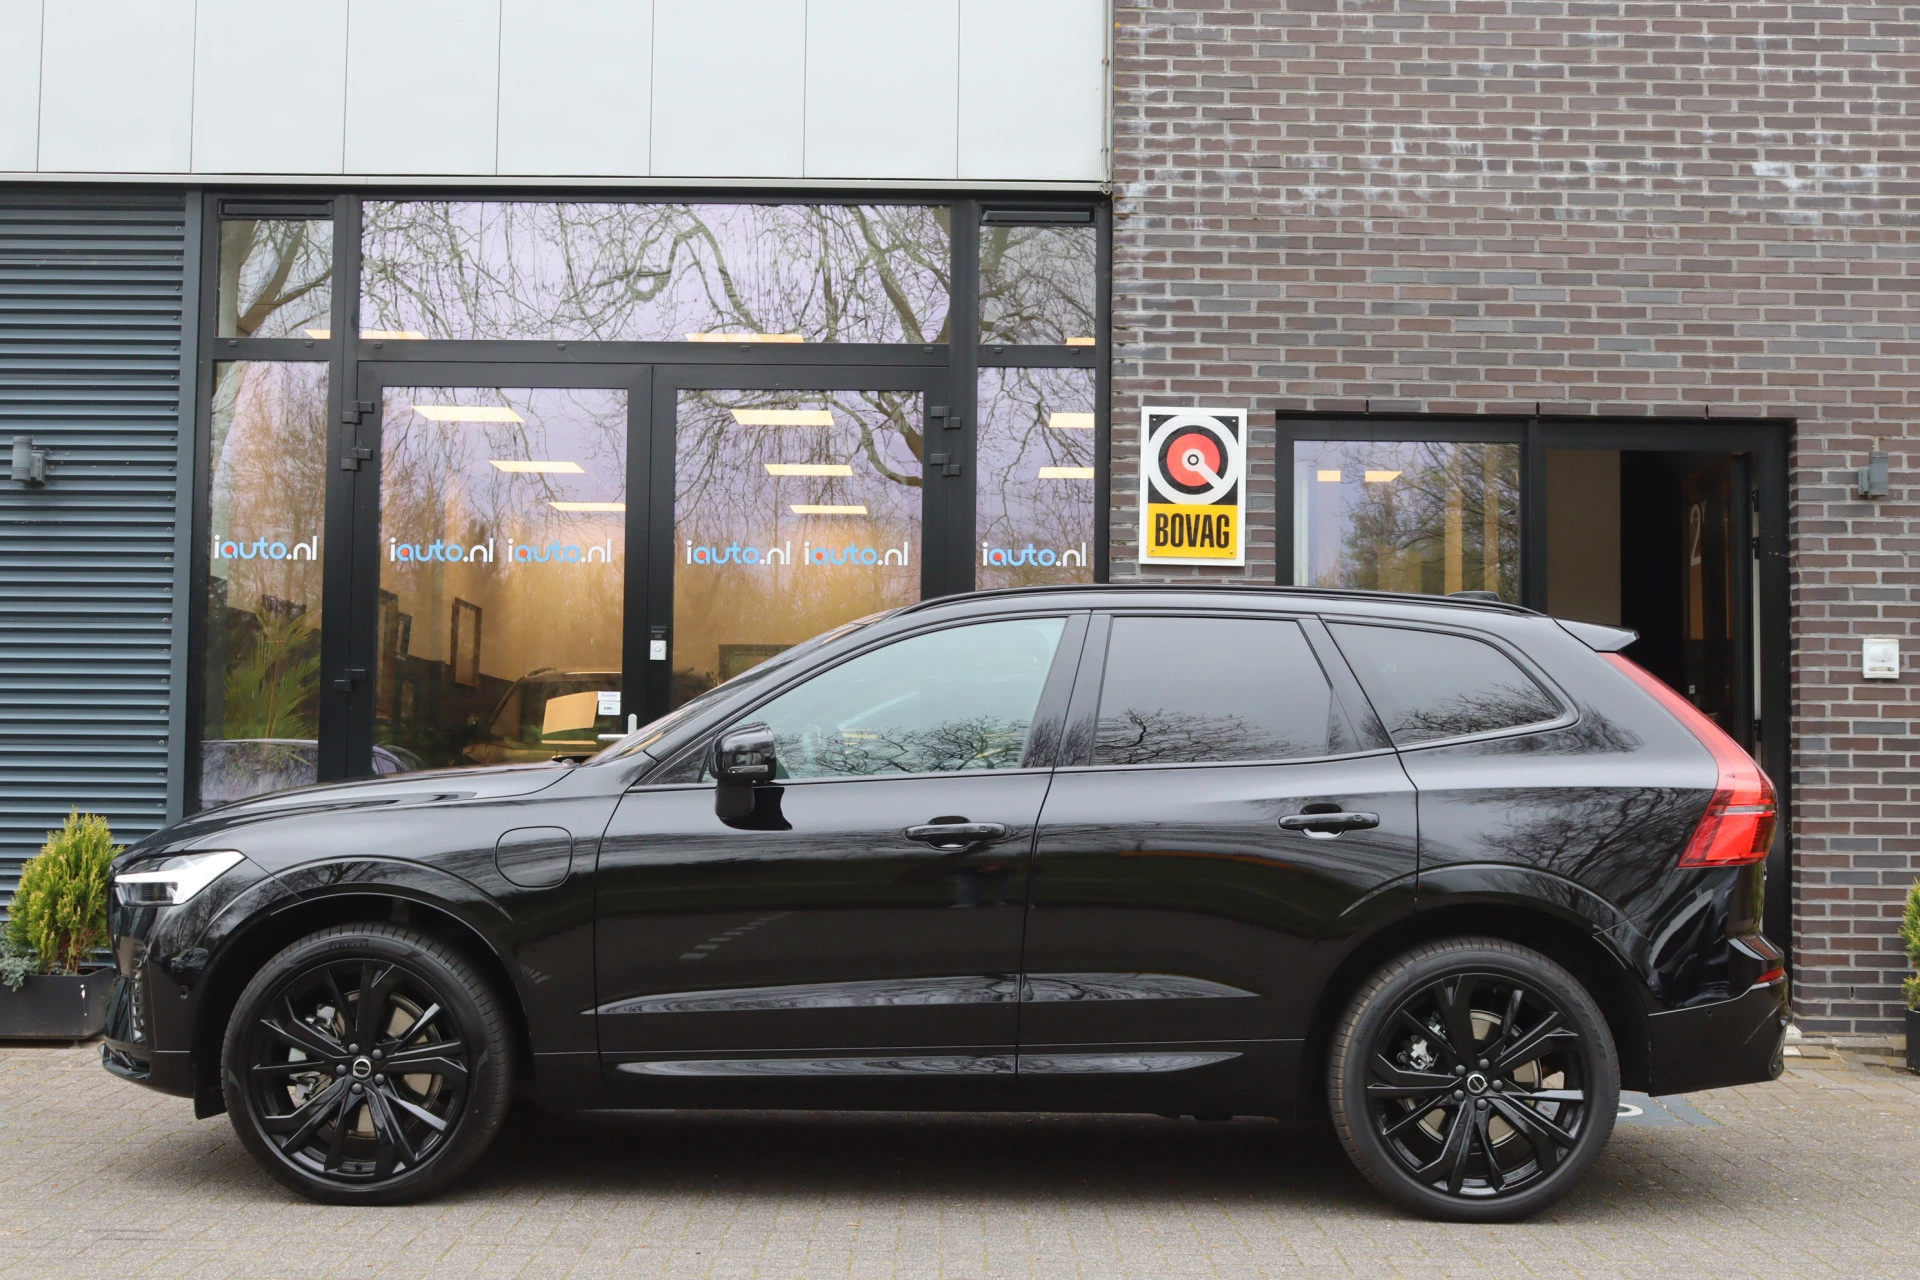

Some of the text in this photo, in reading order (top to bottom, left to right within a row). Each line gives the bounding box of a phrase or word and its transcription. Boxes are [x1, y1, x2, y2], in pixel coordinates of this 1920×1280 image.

[1155, 513, 1230, 548] BOVAG
[214, 534, 318, 560] iauto.nl
[390, 537, 494, 563] iauto.nl
[509, 537, 613, 563] iauto.nl
[686, 539, 791, 565] iauto.nl
[804, 540, 909, 566] iauto.nl
[982, 541, 1087, 567] iauto.nl
